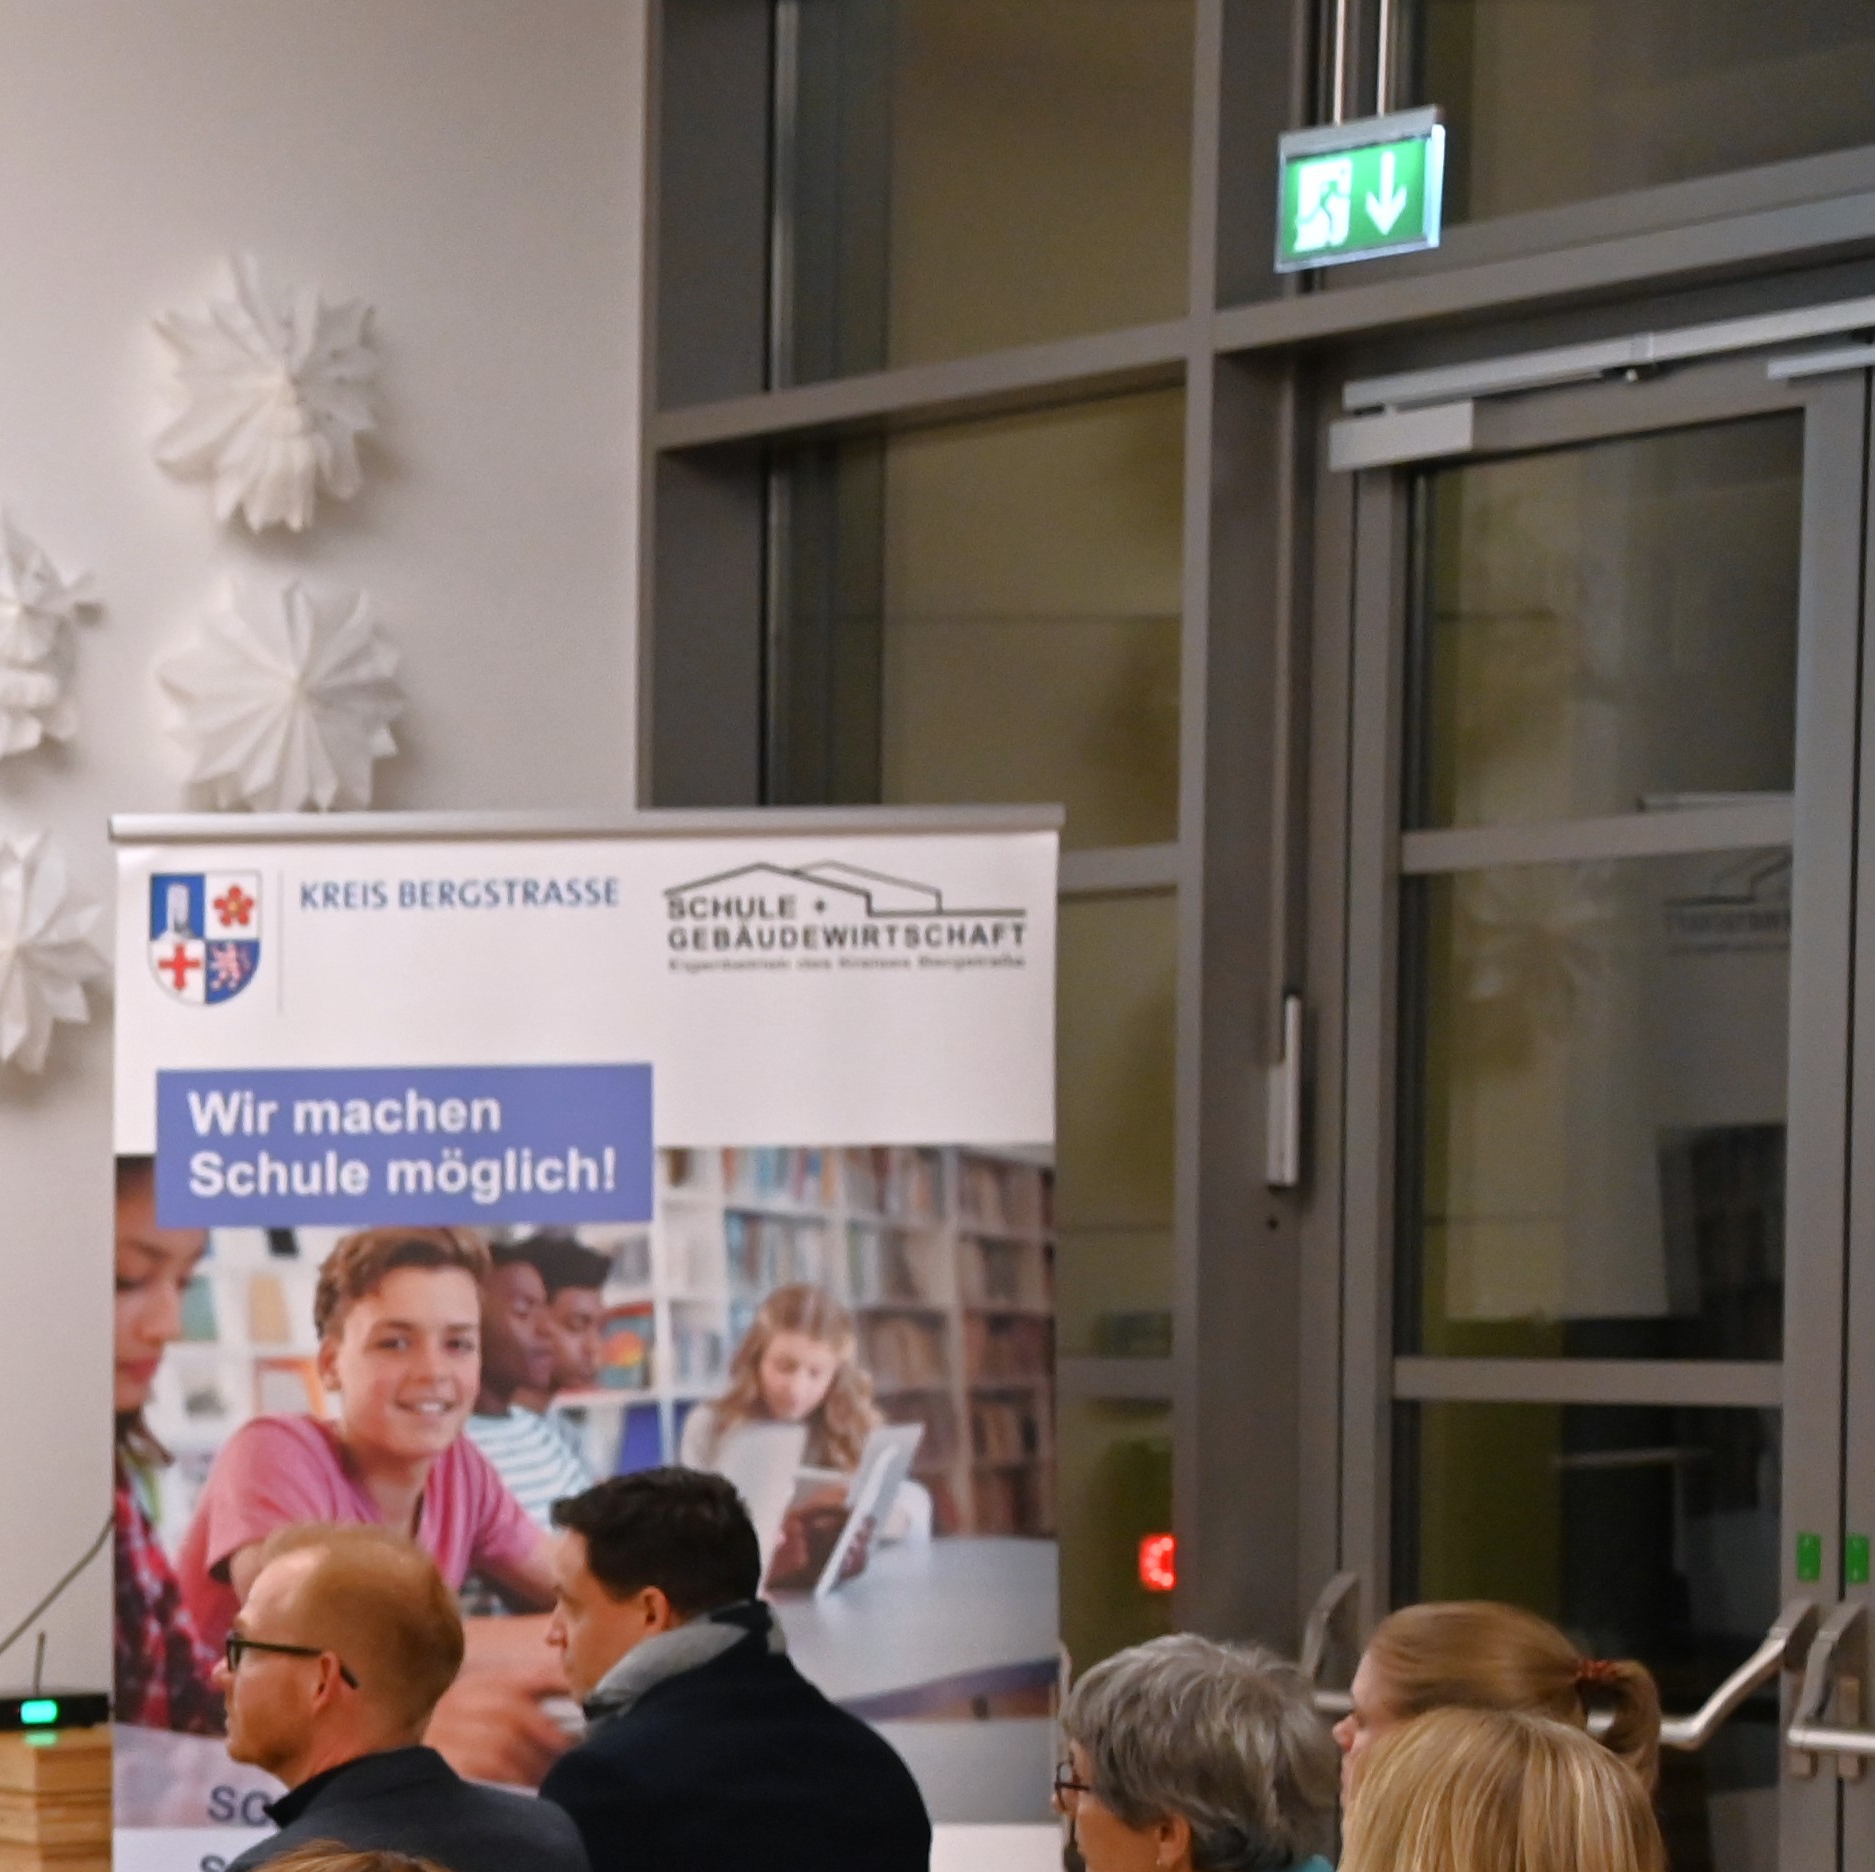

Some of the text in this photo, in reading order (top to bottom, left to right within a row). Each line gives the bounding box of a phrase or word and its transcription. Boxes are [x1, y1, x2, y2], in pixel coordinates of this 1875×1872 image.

[300, 876, 620, 910] KREIS BERGSTRASSE
[666, 895, 797, 920] SCHULE
[668, 920, 1026, 951] GEBÄUDEWIRTSCHAFT
[188, 1090, 501, 1137] Wir machen
[188, 1147, 617, 1206] Schule möglich!
